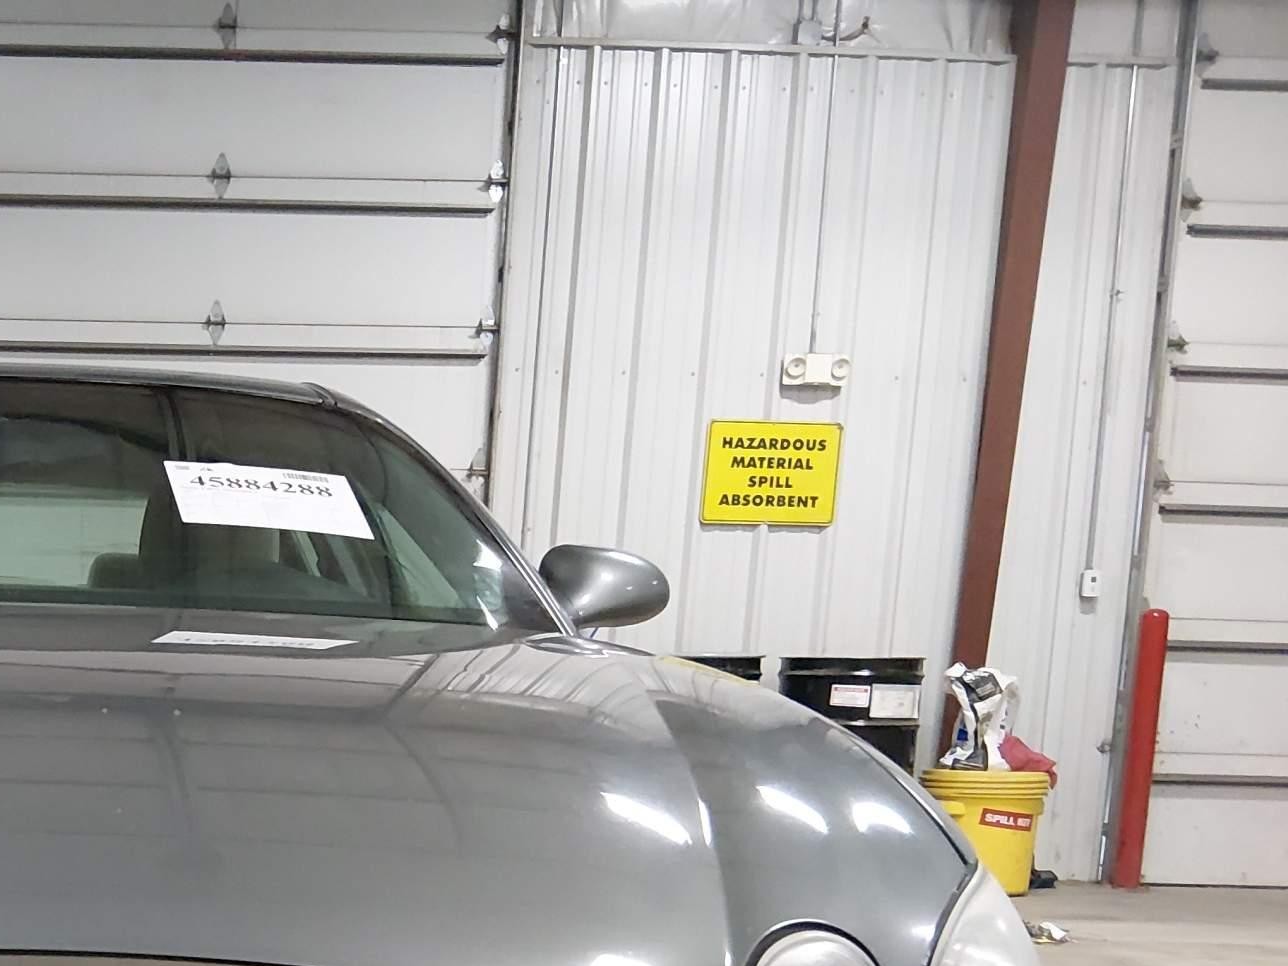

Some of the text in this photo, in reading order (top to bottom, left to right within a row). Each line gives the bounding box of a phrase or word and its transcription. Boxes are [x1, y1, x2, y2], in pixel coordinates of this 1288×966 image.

[722, 437, 827, 451] HAZARDOUS
[731, 456, 813, 470] MATERIAL
[190, 475, 333, 497] 45884288
[747, 476, 793, 488] SPILL
[718, 494, 819, 508] ABSORBENT
[984, 813, 1016, 826] SPILL
